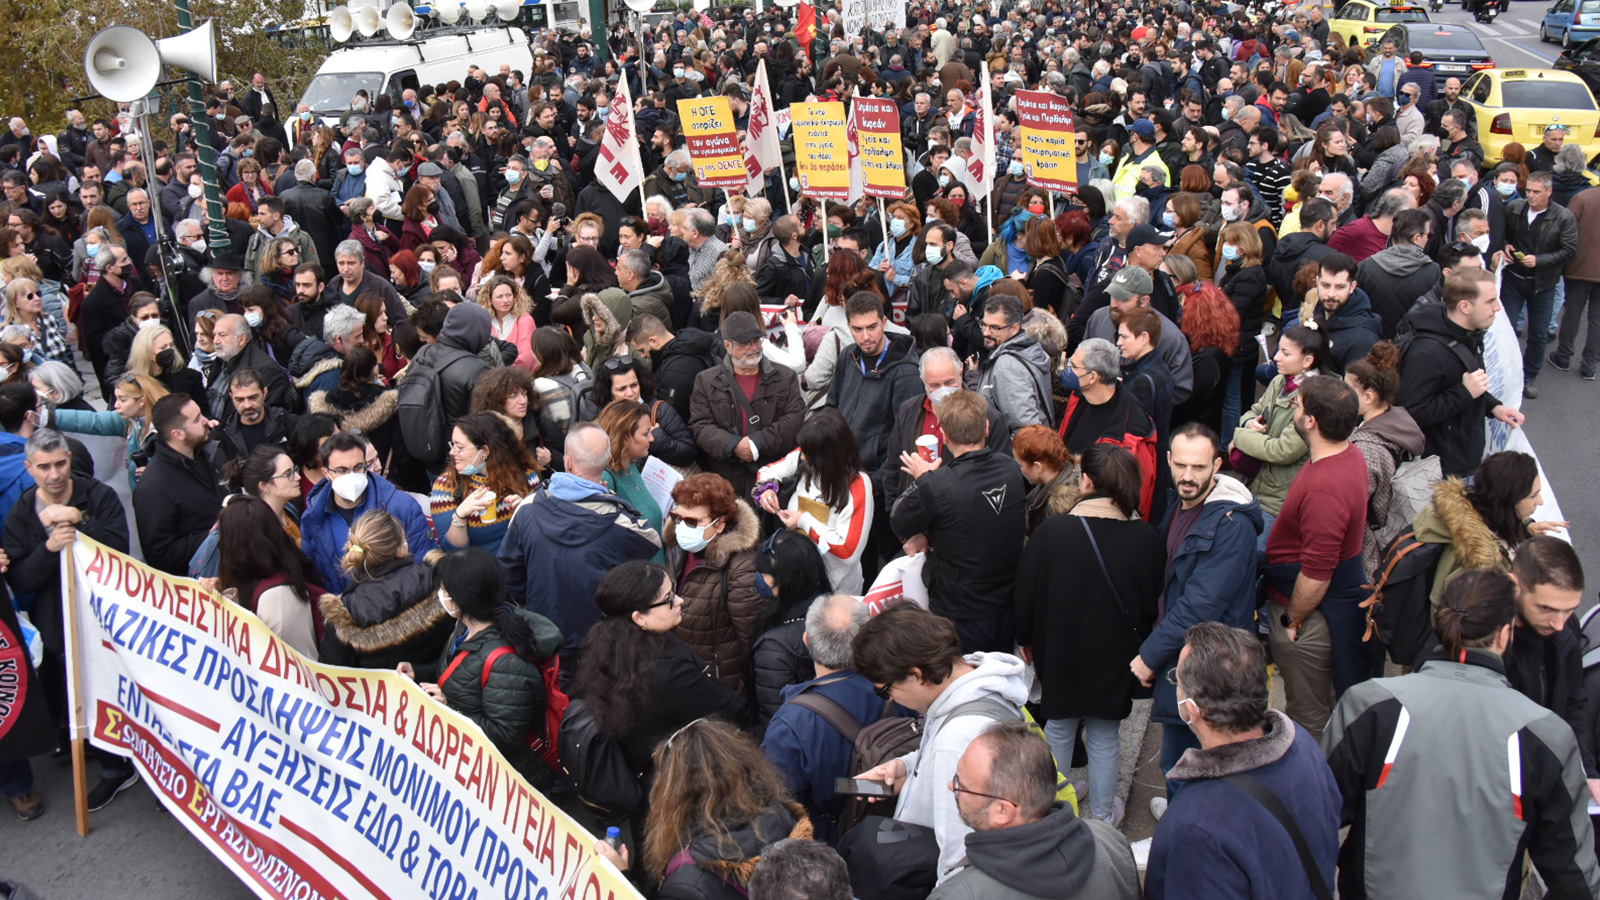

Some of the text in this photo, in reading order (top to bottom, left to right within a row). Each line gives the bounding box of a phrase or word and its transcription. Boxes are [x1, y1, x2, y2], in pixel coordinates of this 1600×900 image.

[691, 106, 715, 116] Η ΟΓΕ
[692, 118, 722, 130] στηρίζει
[706, 136, 730, 148] αγώνα
[1046, 137, 1065, 146] καμία
[717, 160, 743, 170] ΟΕΝΓΕ
[86, 546, 251, 665] ΑΠΟΚΛΕΙΣΤΙΚΑ
[259, 635, 387, 726] ΔΗΜΟΣΙΑ
[395, 690, 408, 739] &
[412, 704, 499, 811] ΔΩΡΕΑΝ
[503, 769, 556, 876] ΥΓΕΙΑ
[89, 590, 197, 675] ΜΑΖΙΚΕΣ
[193, 645, 372, 770] ΠΡΟΣΛΗΨΕΙΣ
[369, 737, 480, 857] ΜΟΝΙΜΟΥ
[103, 707, 188, 800] ΣΩΜΑΤΕΙΟ
[220, 716, 362, 822] ΑΥΞΗΣΕΙΣ
[354, 790, 403, 860] ΕΔΩ
[400, 830, 420, 880] &
[221, 768, 283, 830] ΒΑΕ
